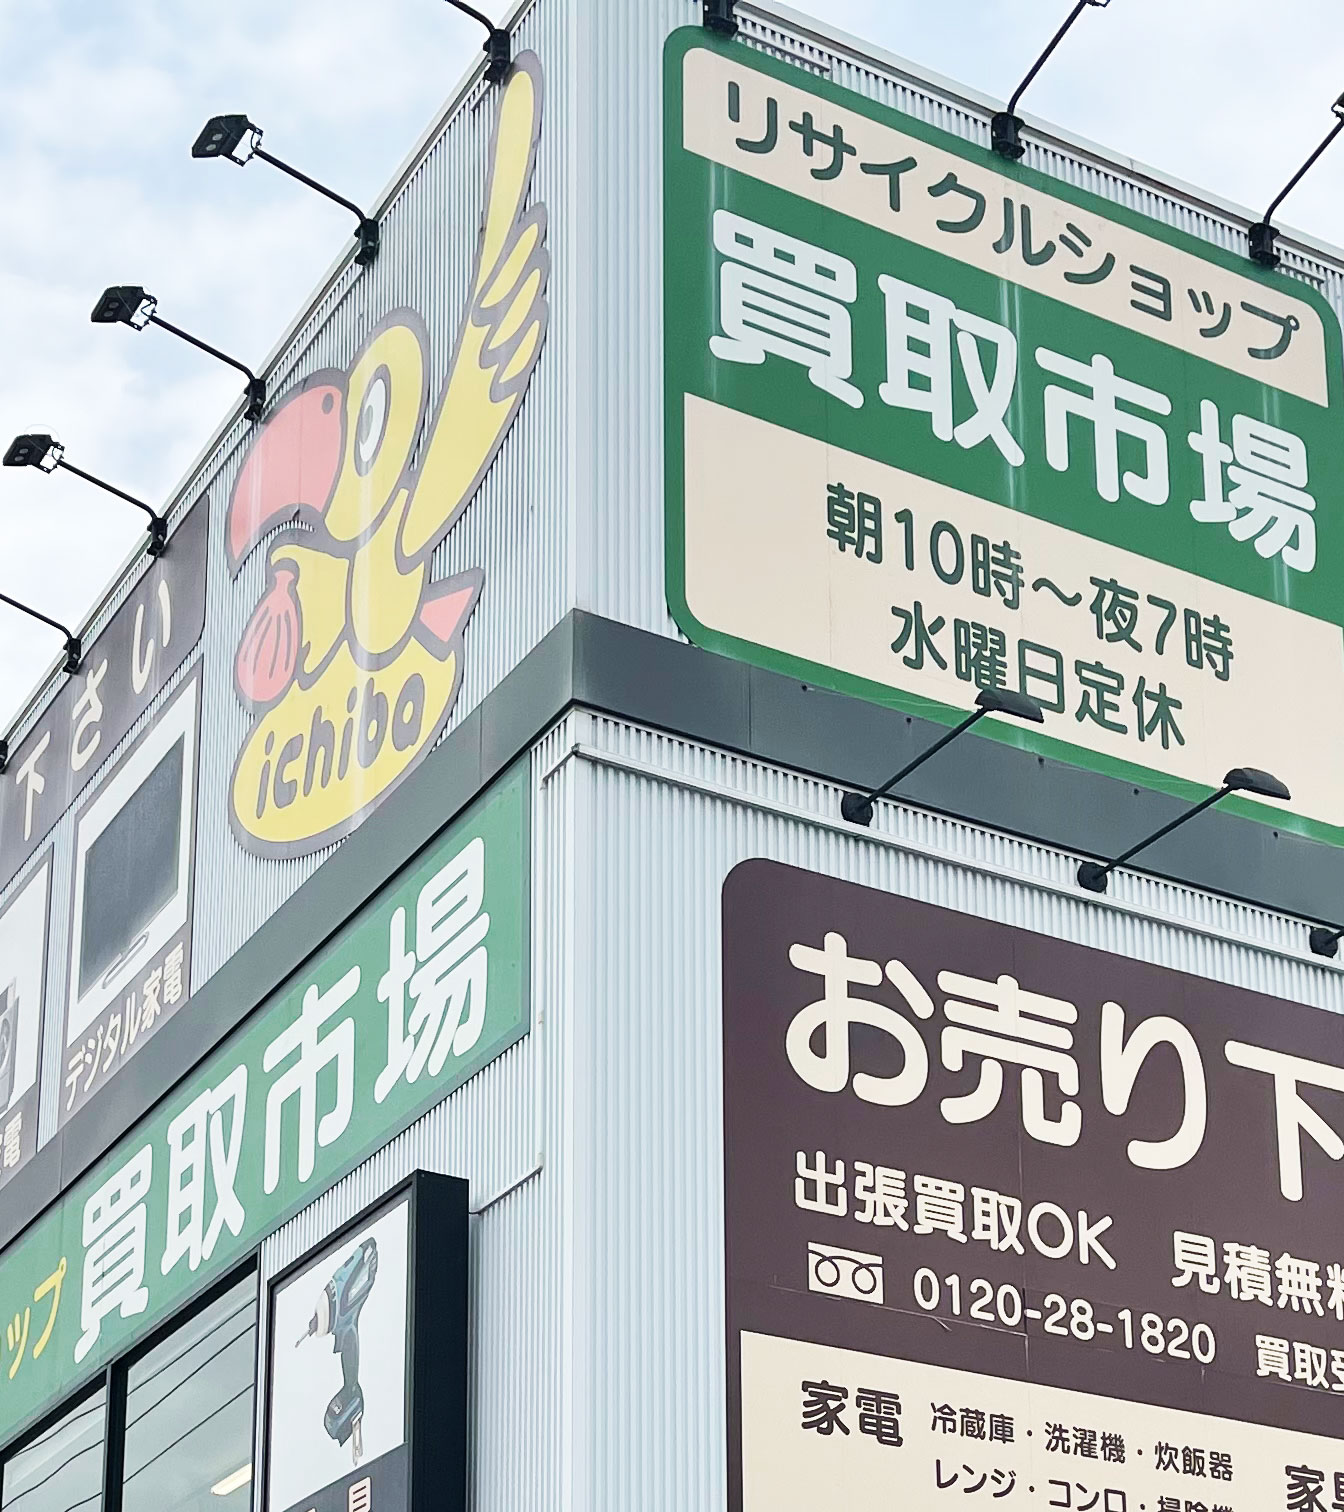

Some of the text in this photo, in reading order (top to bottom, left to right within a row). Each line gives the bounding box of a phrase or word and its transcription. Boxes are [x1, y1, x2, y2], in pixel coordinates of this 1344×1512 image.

[727, 81, 1301, 361] リサイクルショップ
[709, 210, 1317, 573] 買取市場
[257, 669, 427, 819] ichiba
[891, 601, 1188, 749] 水曜日定休
[64, 940, 186, 1113] デジタル家電
[75, 837, 491, 1366] 買取市場
[794, 1151, 1117, 1270] 出張買取OK
[914, 1272, 1217, 1366] 0120-28-1820
[800, 1380, 903, 1450] 家電
